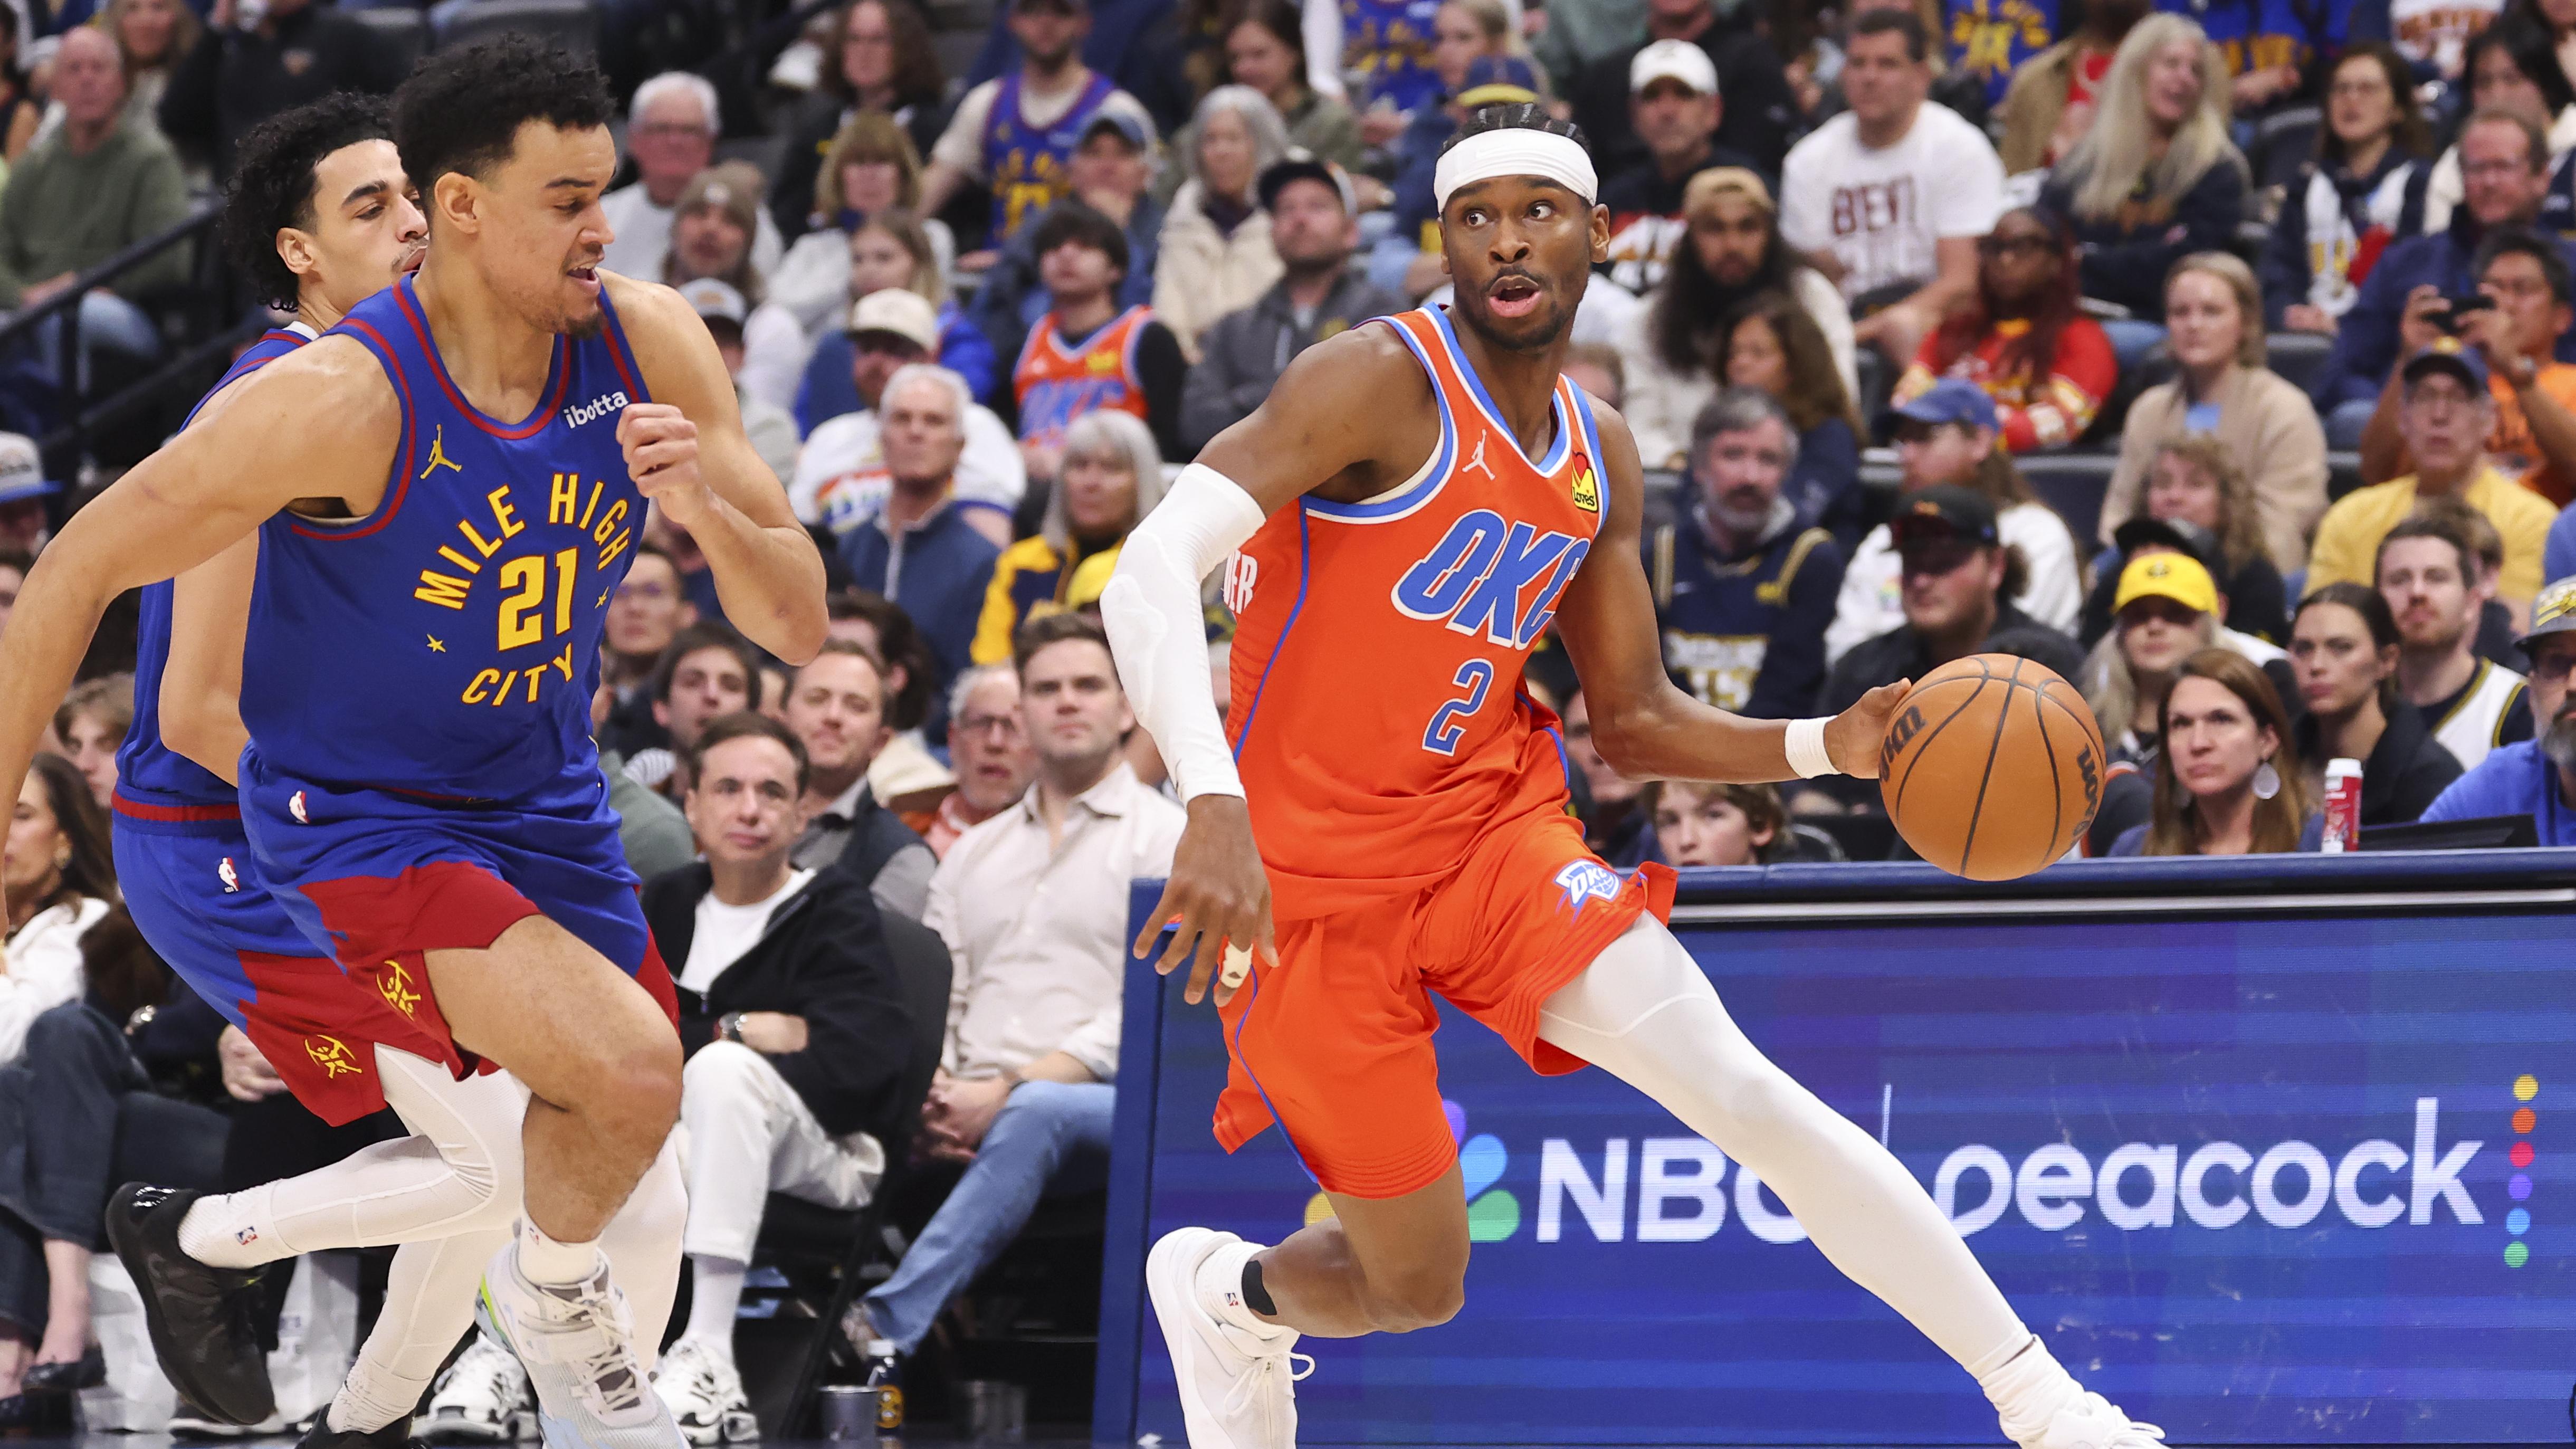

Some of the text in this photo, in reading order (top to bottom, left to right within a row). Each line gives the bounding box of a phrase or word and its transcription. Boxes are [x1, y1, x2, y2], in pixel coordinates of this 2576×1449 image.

[563, 391, 629, 429] ibotta
[414, 472, 631, 610] MILE HIGH
[1390, 508, 1591, 651] OKC
[497, 546, 579, 653] 21
[460, 642, 574, 707] CITY
[1421, 658, 1495, 757] 2
[1934, 1097, 2486, 1239] peacock
